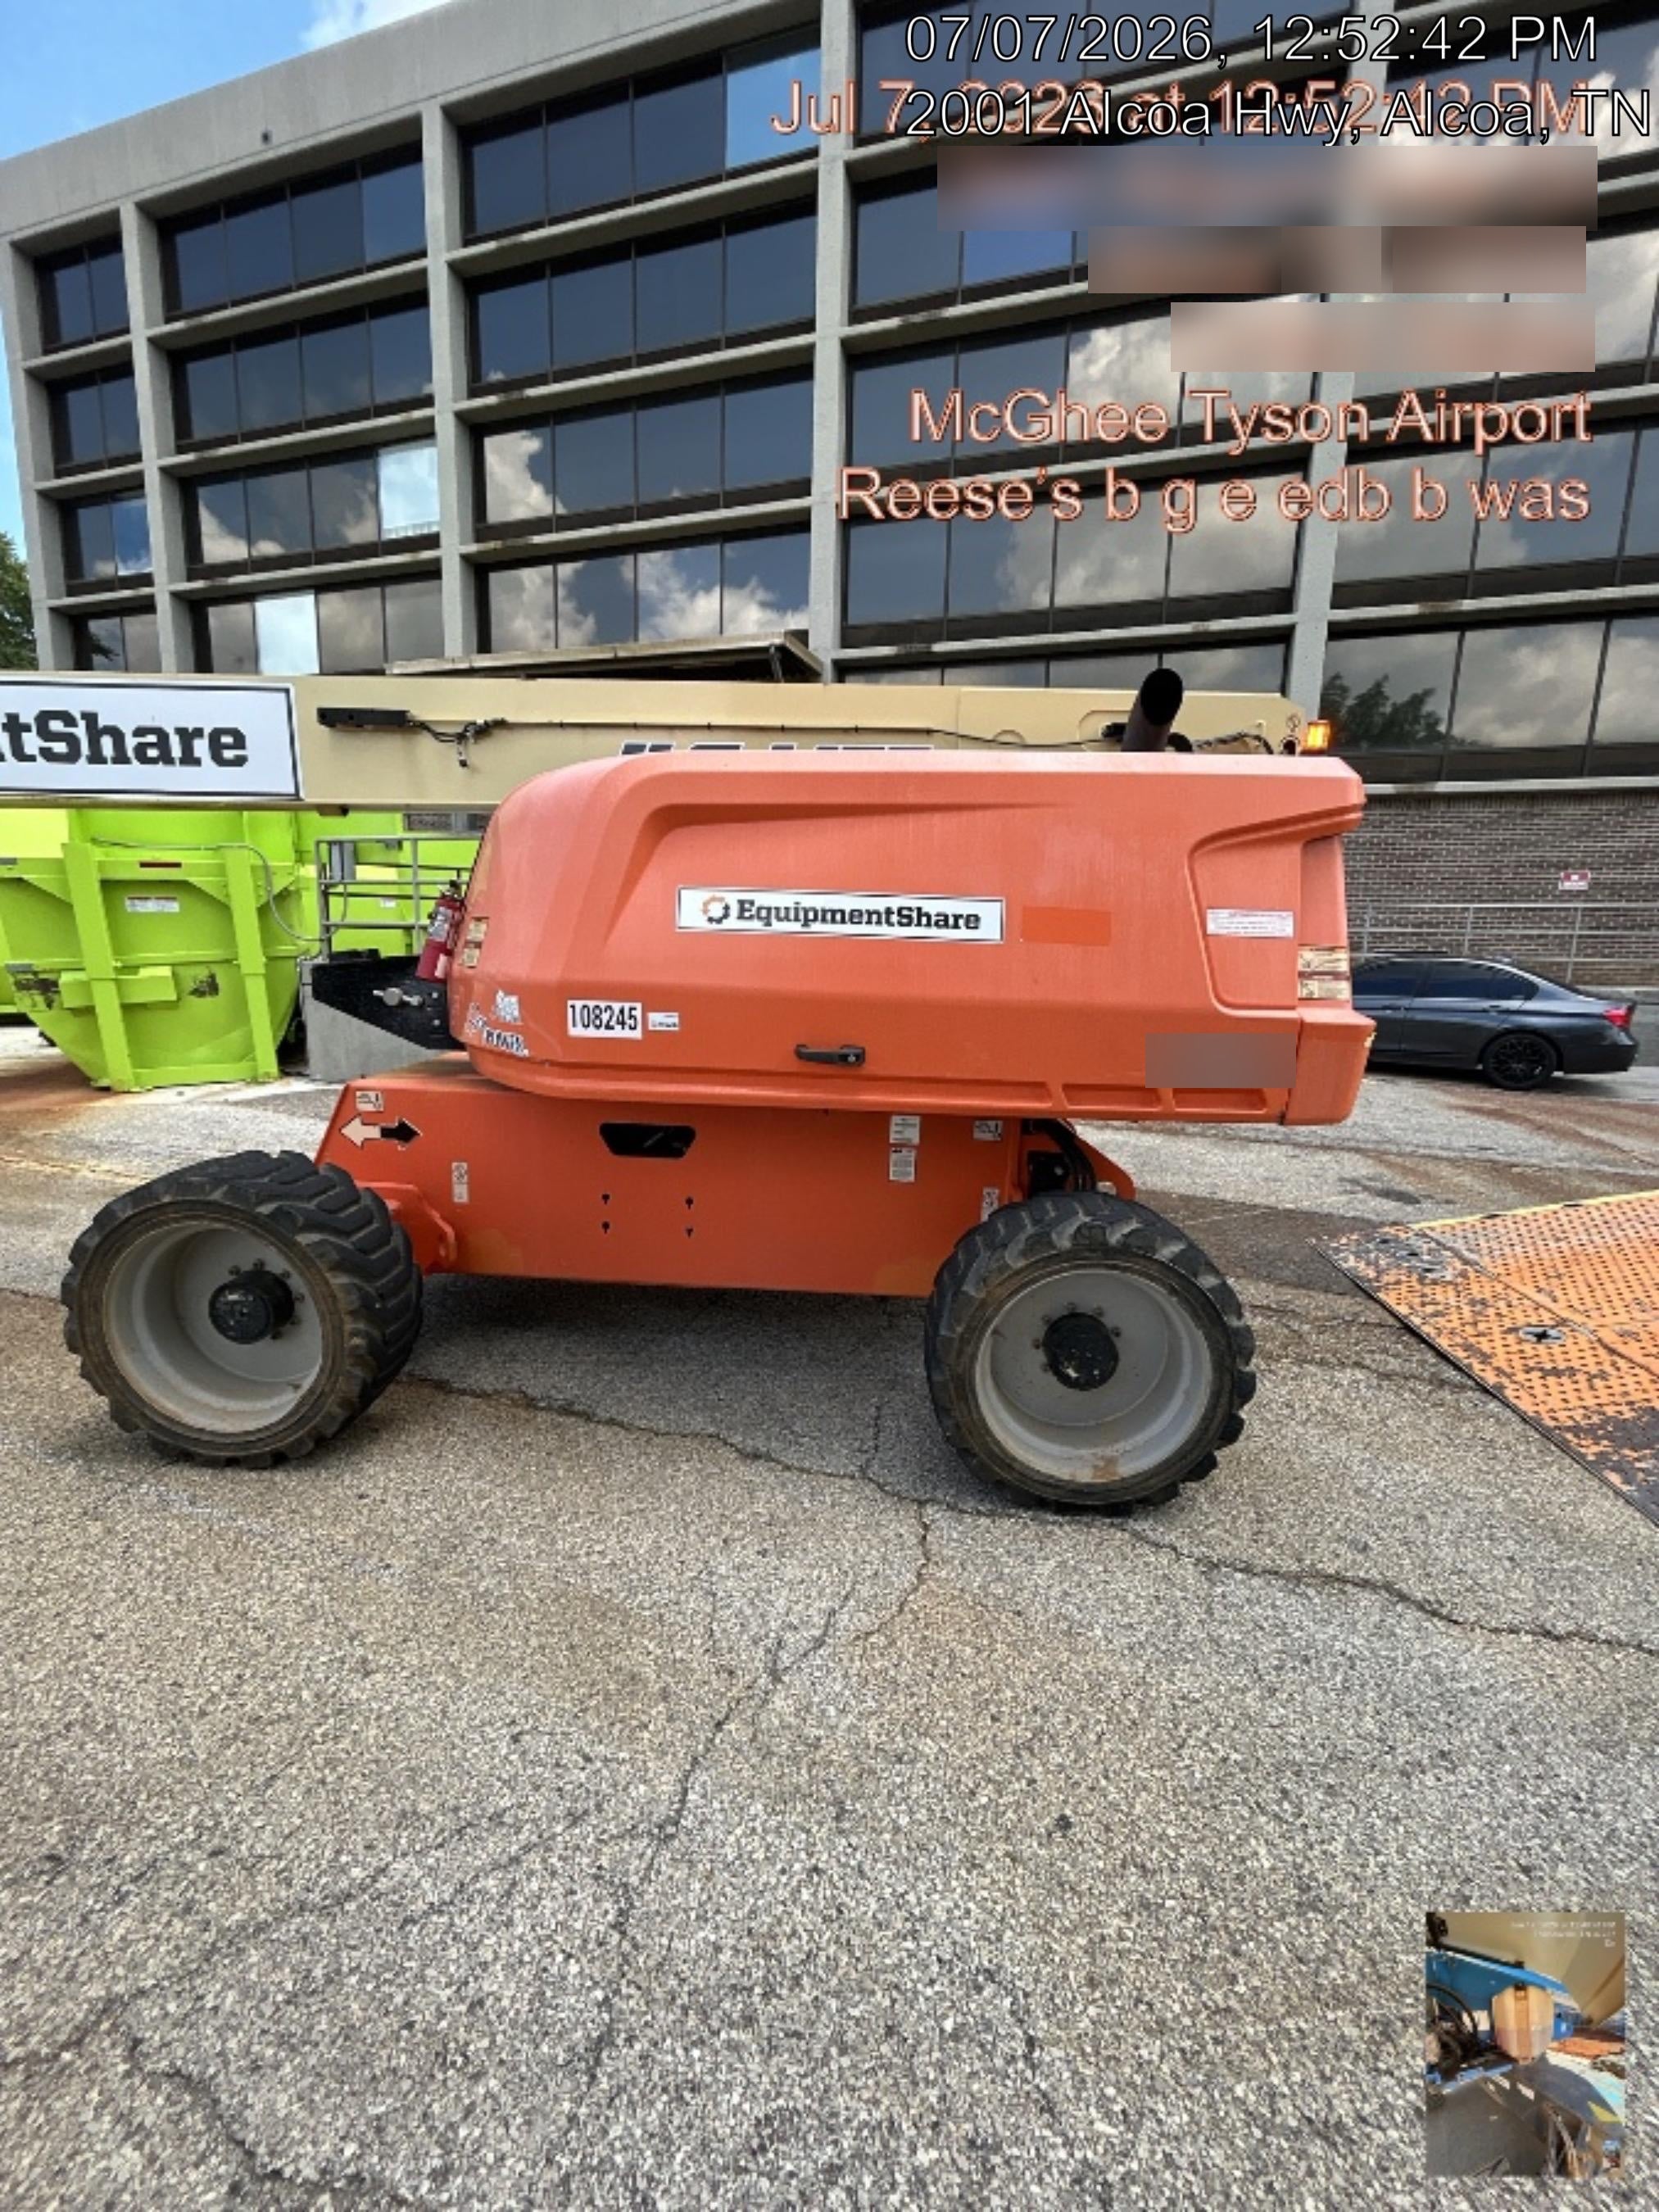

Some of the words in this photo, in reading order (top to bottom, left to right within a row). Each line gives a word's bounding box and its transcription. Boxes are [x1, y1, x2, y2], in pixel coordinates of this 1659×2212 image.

[0, 709, 248, 768] tShare
[737, 898, 981, 931] EquipmentShare
[569, 1004, 637, 1031] 108245
